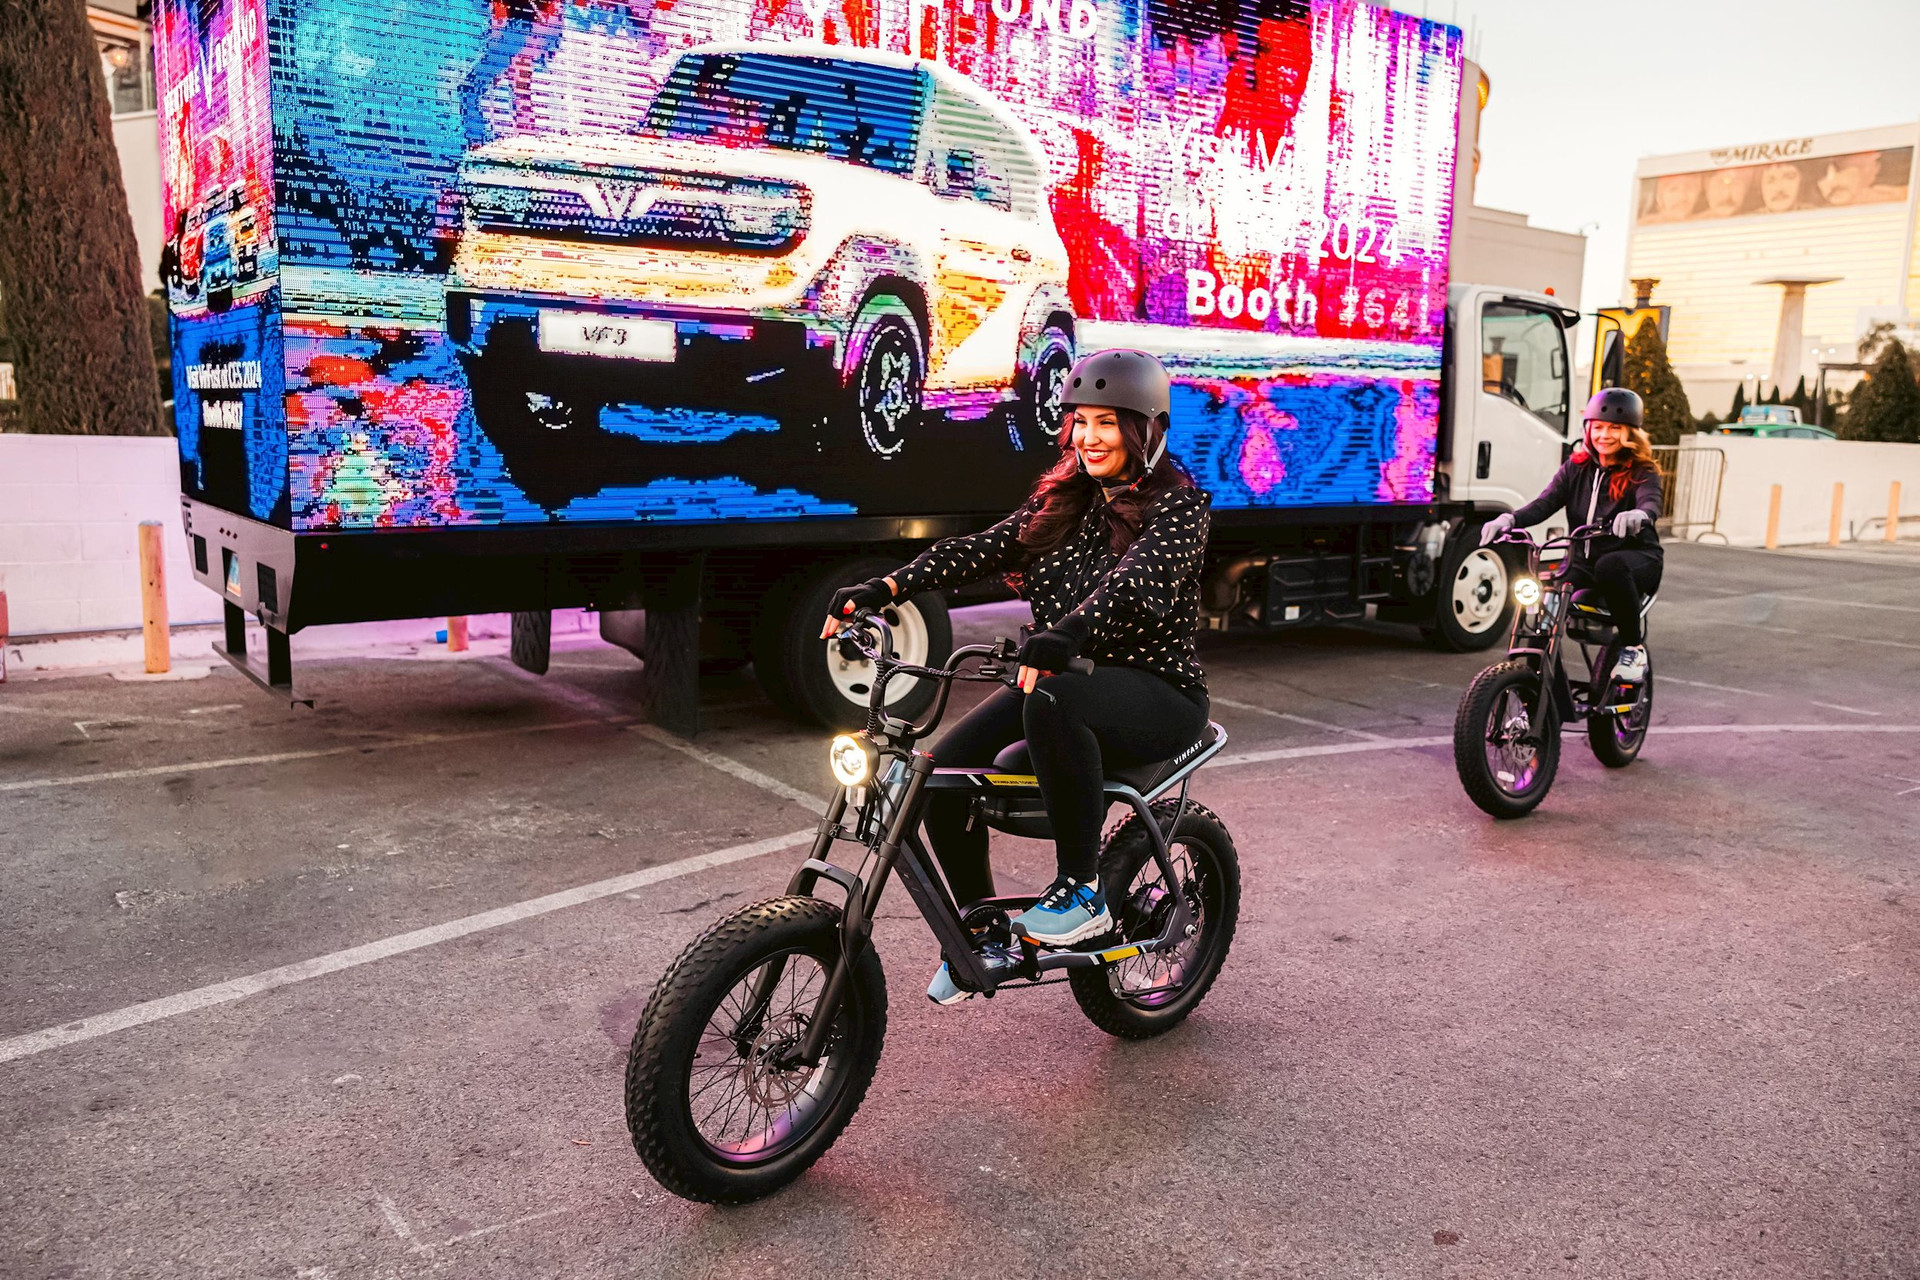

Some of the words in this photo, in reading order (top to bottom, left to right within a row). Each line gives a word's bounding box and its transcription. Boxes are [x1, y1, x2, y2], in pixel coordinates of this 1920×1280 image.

[1732, 138, 1813, 161] MIRAGE
[1311, 217, 1402, 267] 2024
[1186, 268, 1318, 324] Booth
[228, 361, 242, 389] CES
[1173, 739, 1203, 765] VINFAST
